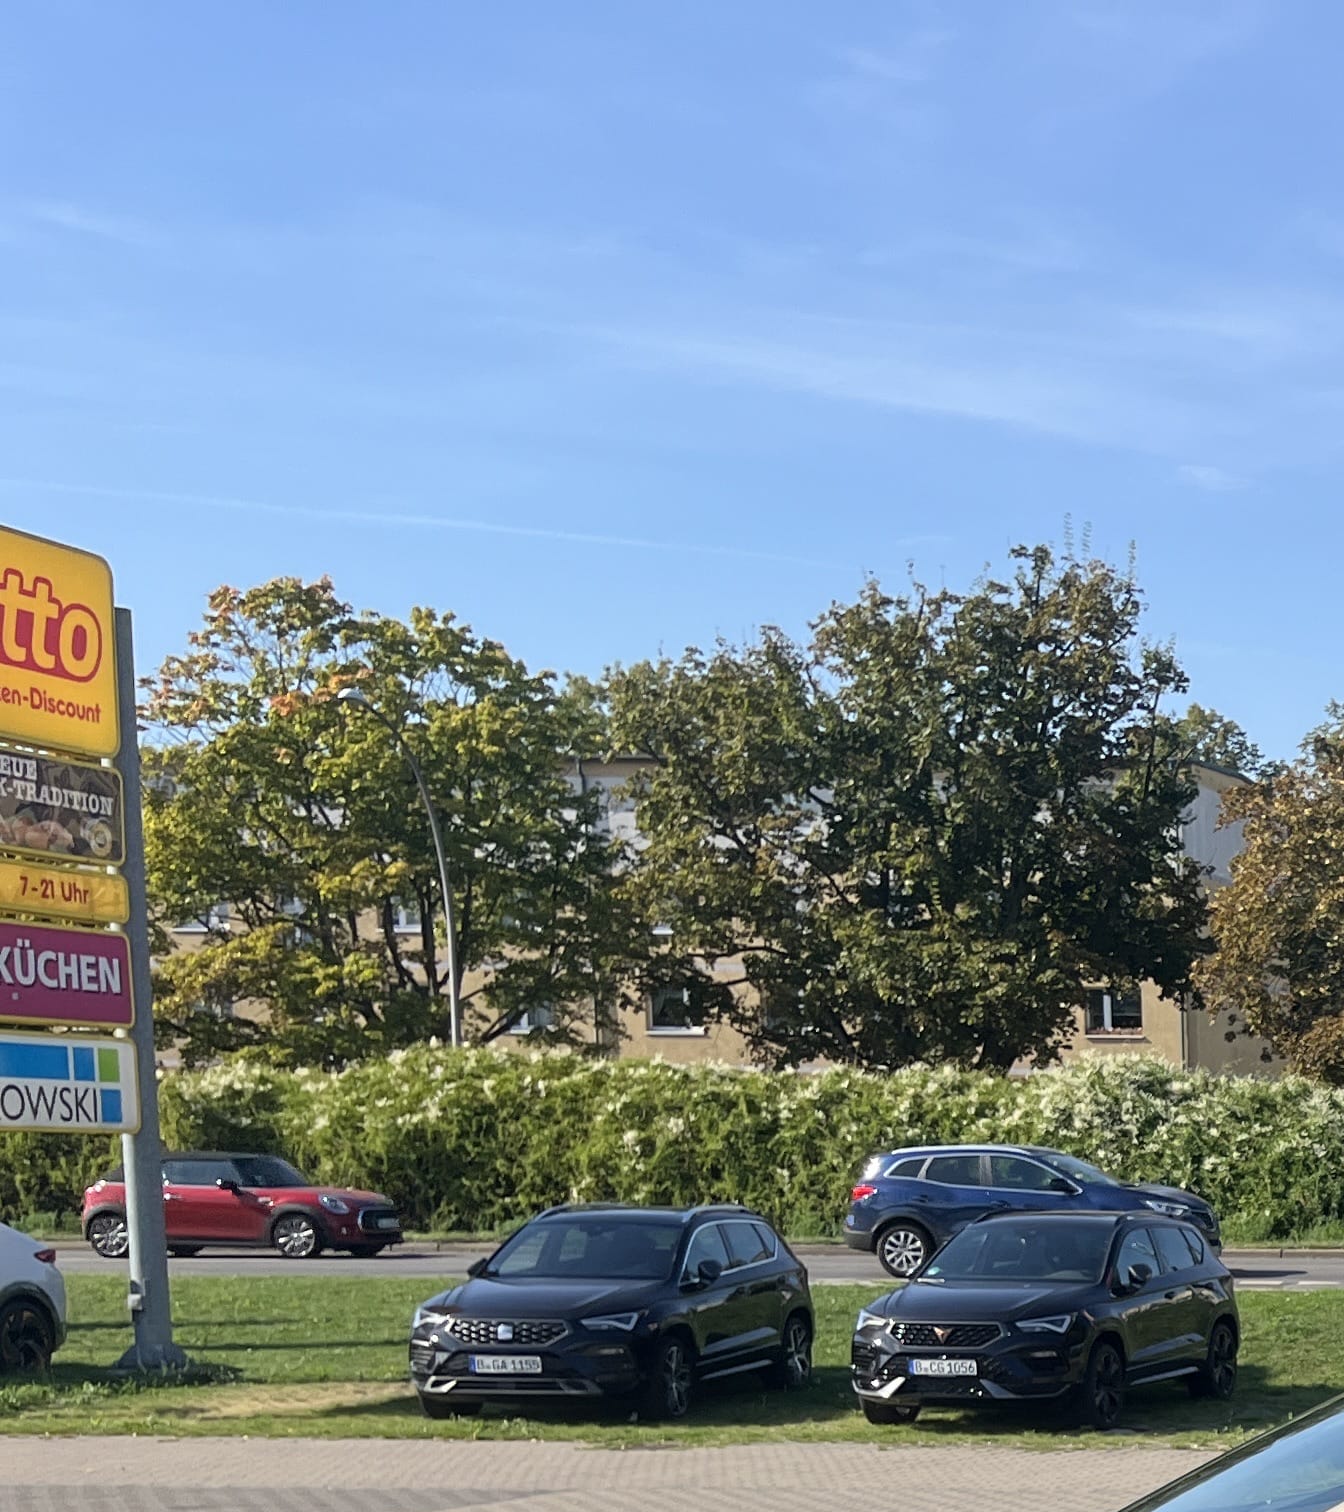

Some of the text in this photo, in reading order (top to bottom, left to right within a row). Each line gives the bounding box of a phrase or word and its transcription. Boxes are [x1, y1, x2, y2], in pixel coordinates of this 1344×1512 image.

[0, 686, 102, 724] en-Discount
[61, 880, 90, 905] Uhr
[0, 1084, 98, 1123] OWSKI
